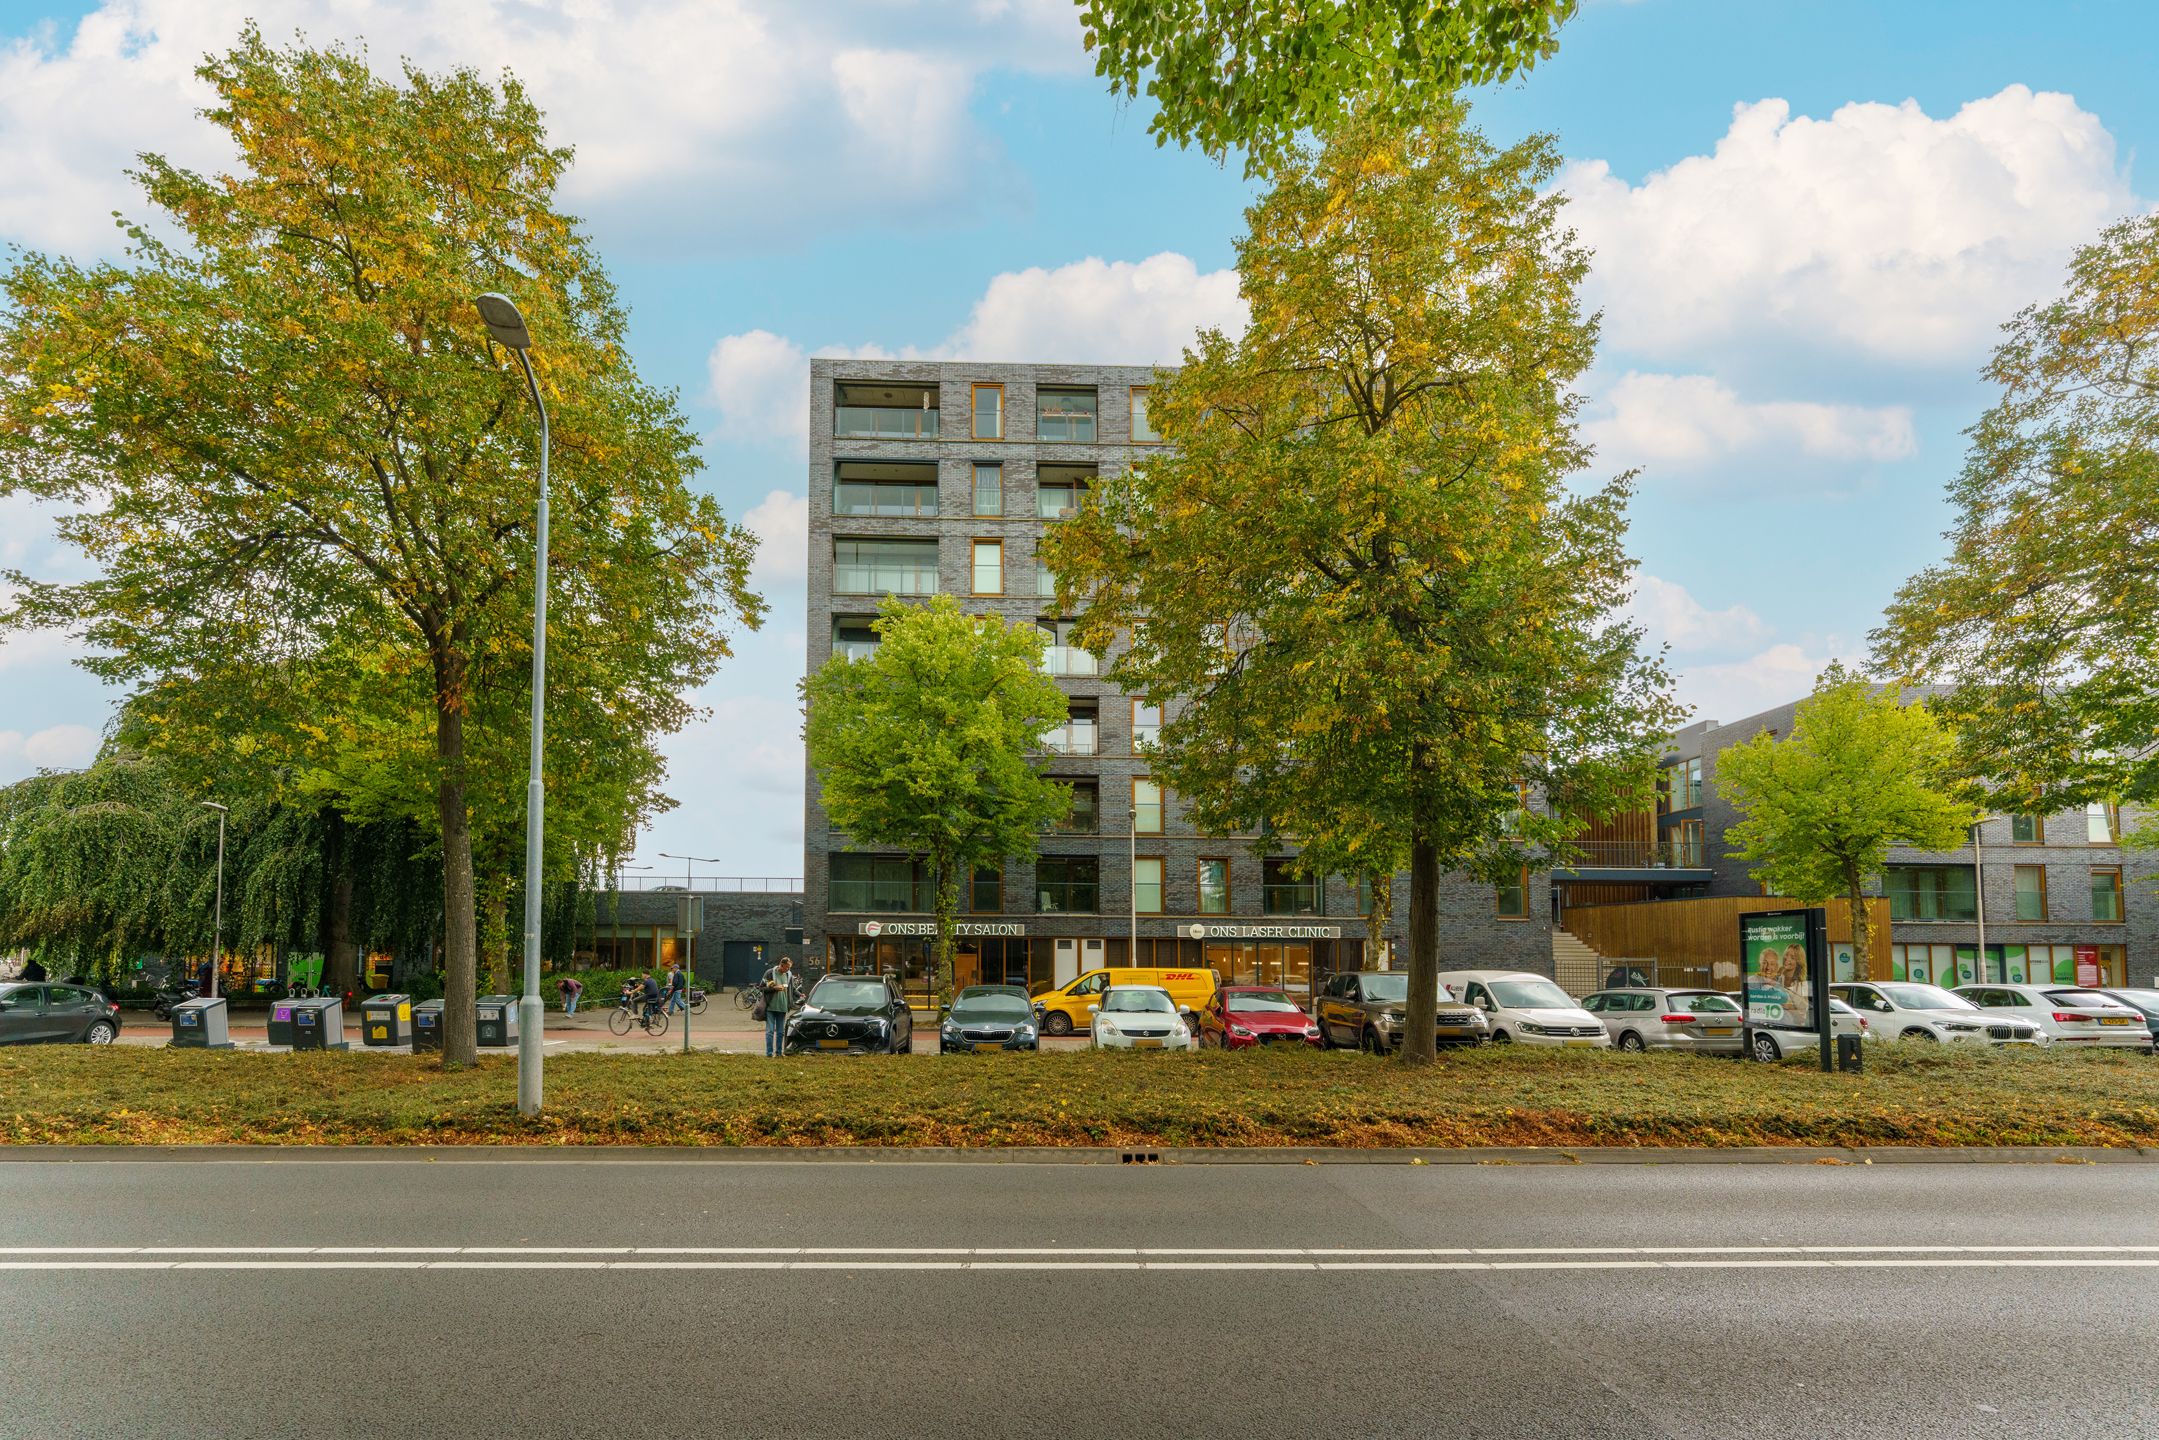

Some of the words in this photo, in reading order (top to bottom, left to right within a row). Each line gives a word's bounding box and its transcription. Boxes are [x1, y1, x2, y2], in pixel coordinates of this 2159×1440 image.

[888, 923, 916, 935] ONS
[918, 923, 971, 935] BETY
[974, 924, 1018, 935] SALON
[1210, 926, 1237, 937] ONS
[1242, 926, 1283, 938] LASER
[1288, 926, 1330, 938] CLINIC
[1747, 933, 1772, 941] worden
[1780, 932, 1805, 940] voorbij!
[808, 956, 820, 966] 56
[1165, 973, 1195, 981] DHL
[1765, 1004, 1781, 1019] 10
